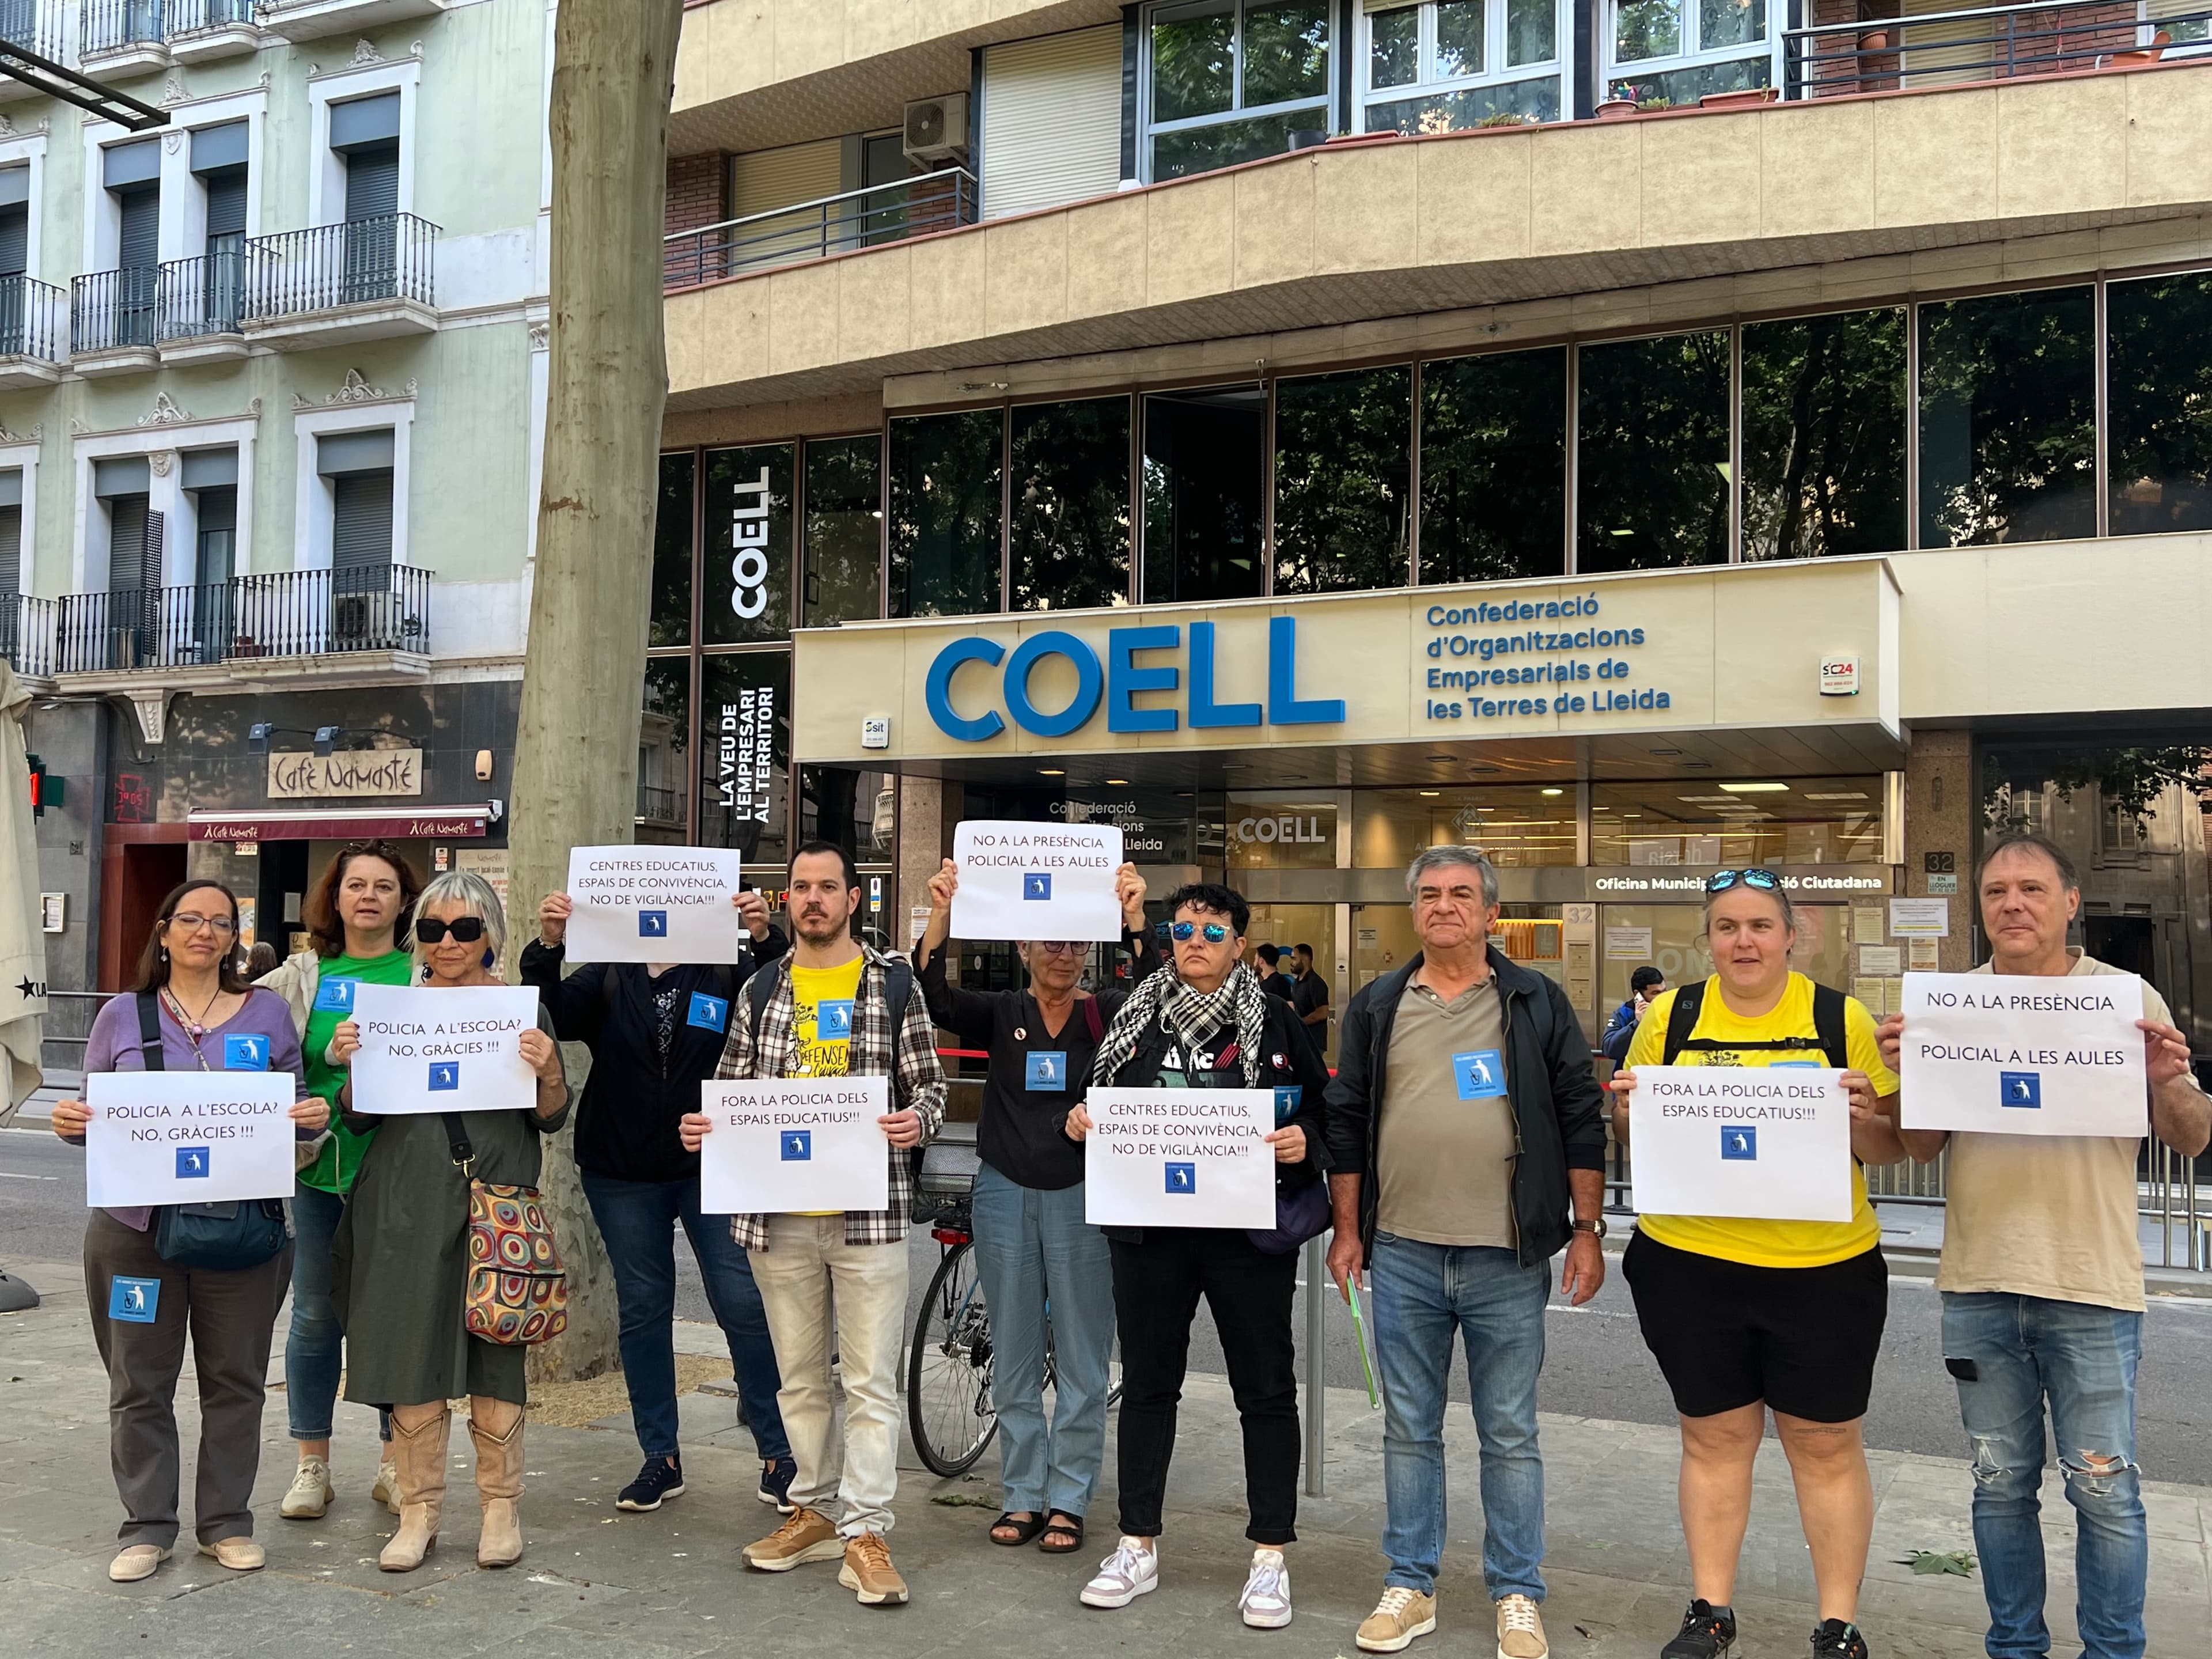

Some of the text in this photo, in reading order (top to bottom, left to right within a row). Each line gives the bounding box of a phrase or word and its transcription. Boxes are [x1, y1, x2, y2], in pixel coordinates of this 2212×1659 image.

[731, 466, 770, 619] COELL
[1426, 592, 1599, 626] Confederació
[1426, 628, 1645, 661] d'Organitzacions
[925, 616, 1346, 741] COELL
[1427, 658, 1630, 692] Empresarials de
[1427, 688, 1672, 719] les Terres de Lleida
[719, 704, 737, 806] LA VEU DE
[736, 690, 755, 821] L'EMPRESARI
[755, 687, 773, 824] AL TERRITORI
[324, 753, 412, 791] Namasté
[1238, 816, 1325, 843] COELL
[974, 834, 1104, 849] NO A LA PRESÈNCIA
[1124, 838, 1163, 851] Lleida
[589, 861, 718, 873] CENTRES EDUCATIUS,
[968, 855, 1109, 868] POLICIAL A LES AULES
[1929, 854, 1953, 872] 32
[578, 876, 728, 889] ESPAIS DE CONVIVÈNCIA,
[1596, 877, 1707, 892] Oficina Municip
[1802, 876, 1882, 889] Ciutadana
[590, 893, 714, 905] NO DE VIGILÀNCIA!!!
[1569, 907, 1593, 924] 32
[1927, 992, 2115, 1011] NO A LA PRESÈNCIA
[369, 1018, 521, 1035] POLICIA A L'ESCOLA?
[389, 1040, 499, 1058] NO, GRÀCIES !!!
[1921, 1044, 2124, 1065] POLICIAL A LES AULES
[722, 1092, 868, 1107] FORA LA POLICIA DELS
[1653, 1083, 1825, 1099] FORA LA POLICIA DELS
[107, 1102, 278, 1119] POLICIA A L'ESCOLA?
[730, 1112, 859, 1126] ESPAIS EDUCATIUS!!!
[1109, 1104, 1251, 1118] CENTRES EDUCATIUS,
[1662, 1105, 1815, 1120] ESPAIS EDUCATIUS!!!
[131, 1124, 253, 1142] NO, GRÀCIES !!!
[1099, 1122, 1262, 1138] ESPAIS DE CONVIVÈNCIA,
[1112, 1142, 1249, 1157] NO DE VIGILÀNCIA!!!
